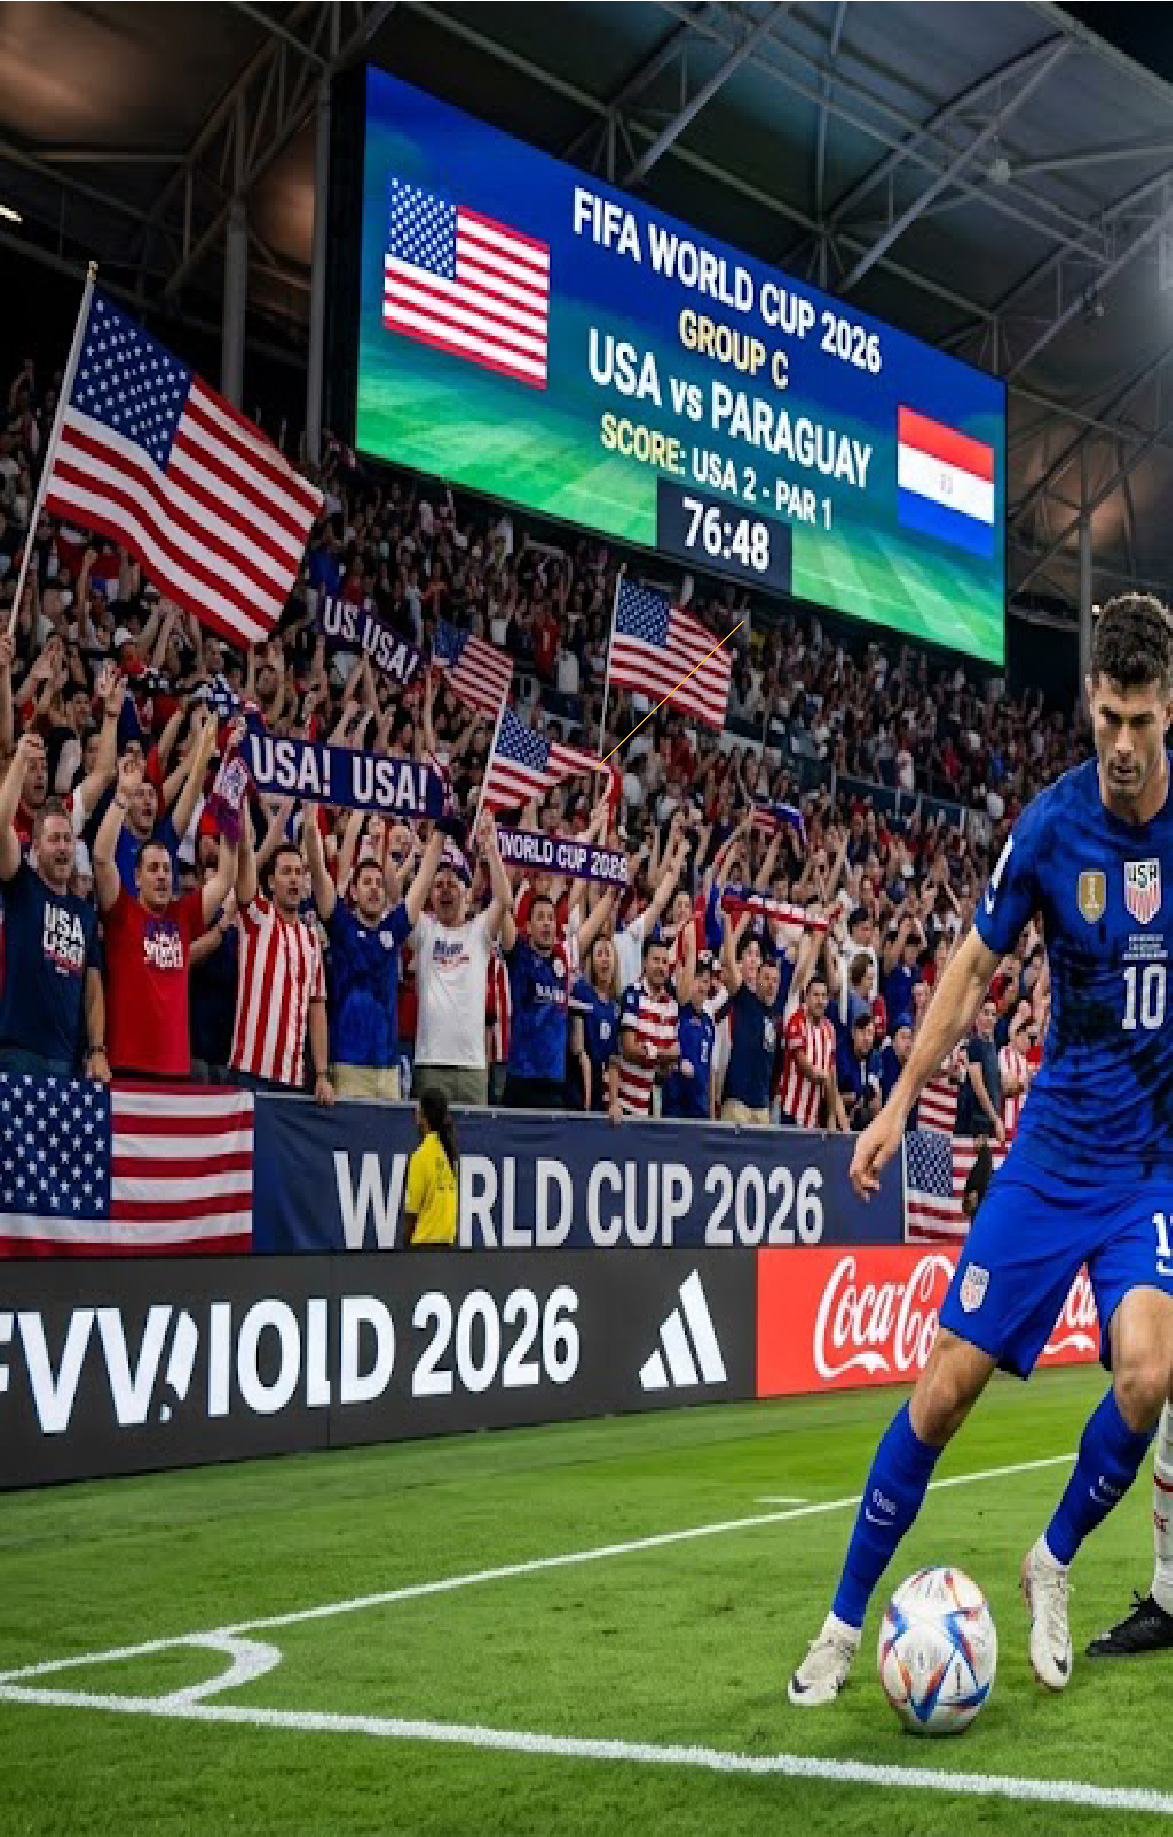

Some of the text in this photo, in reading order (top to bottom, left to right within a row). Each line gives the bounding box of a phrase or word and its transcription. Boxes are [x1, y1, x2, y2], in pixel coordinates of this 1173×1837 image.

[573, 185, 882, 374] FIFA WORLD CUP 2026
[679, 308, 789, 390] GROUP C
[588, 327, 662, 406] USA
[711, 381, 873, 488] PARAGUAY
[600, 412, 687, 476] SCORE:
[691, 447, 737, 496] USA
[742, 467, 757, 504] 2
[775, 477, 816, 525] PAR
[822, 497, 833, 531] 1
[682, 496, 770, 574] 76:48
[362, 616, 418, 685] USA!
[250, 733, 331, 797] USA!
[352, 756, 428, 813] USA!
[558, 844, 587, 870] CUP
[1121, 964, 1168, 1031] 10
[333, 1150, 574, 1250] WRLD
[585, 1160, 692, 1247] CUP
[704, 1164, 824, 1247] 2026
[411, 1283, 581, 1397] 2026
